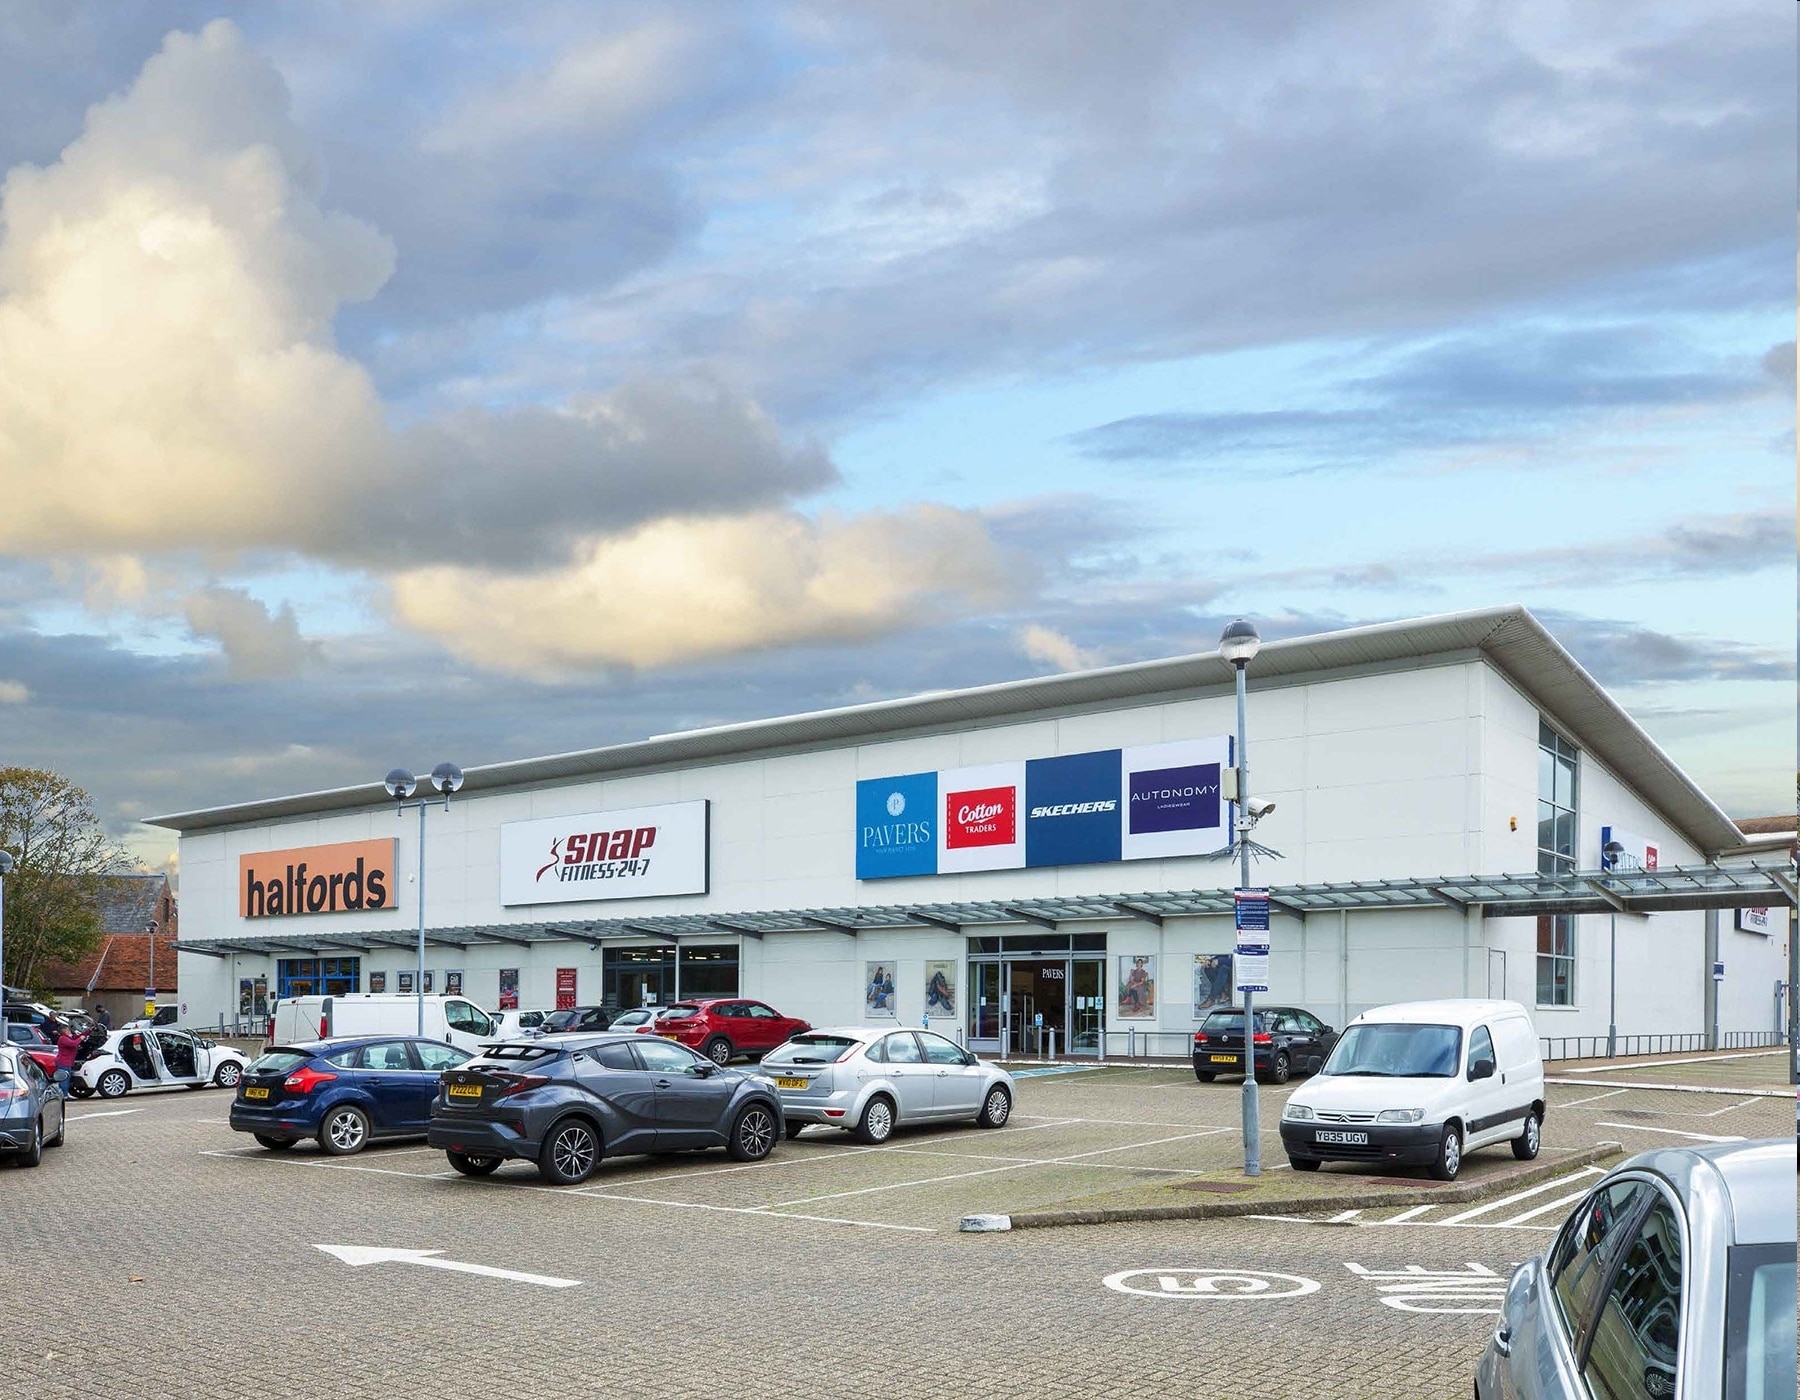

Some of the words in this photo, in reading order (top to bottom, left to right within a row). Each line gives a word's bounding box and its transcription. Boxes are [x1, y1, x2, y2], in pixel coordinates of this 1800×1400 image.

[1131, 784, 1218, 801] AUTONOMY
[958, 803, 1004, 825] Cotton
[1030, 800, 1117, 818] SKECHERS
[863, 821, 930, 848] PAVERS
[965, 824, 997, 834] TRADERS
[247, 857, 386, 916] halfords
[1042, 968, 1064, 979] PAVERS
[1317, 1131, 1343, 1142] Y835
[1345, 1133, 1367, 1143] UGV
